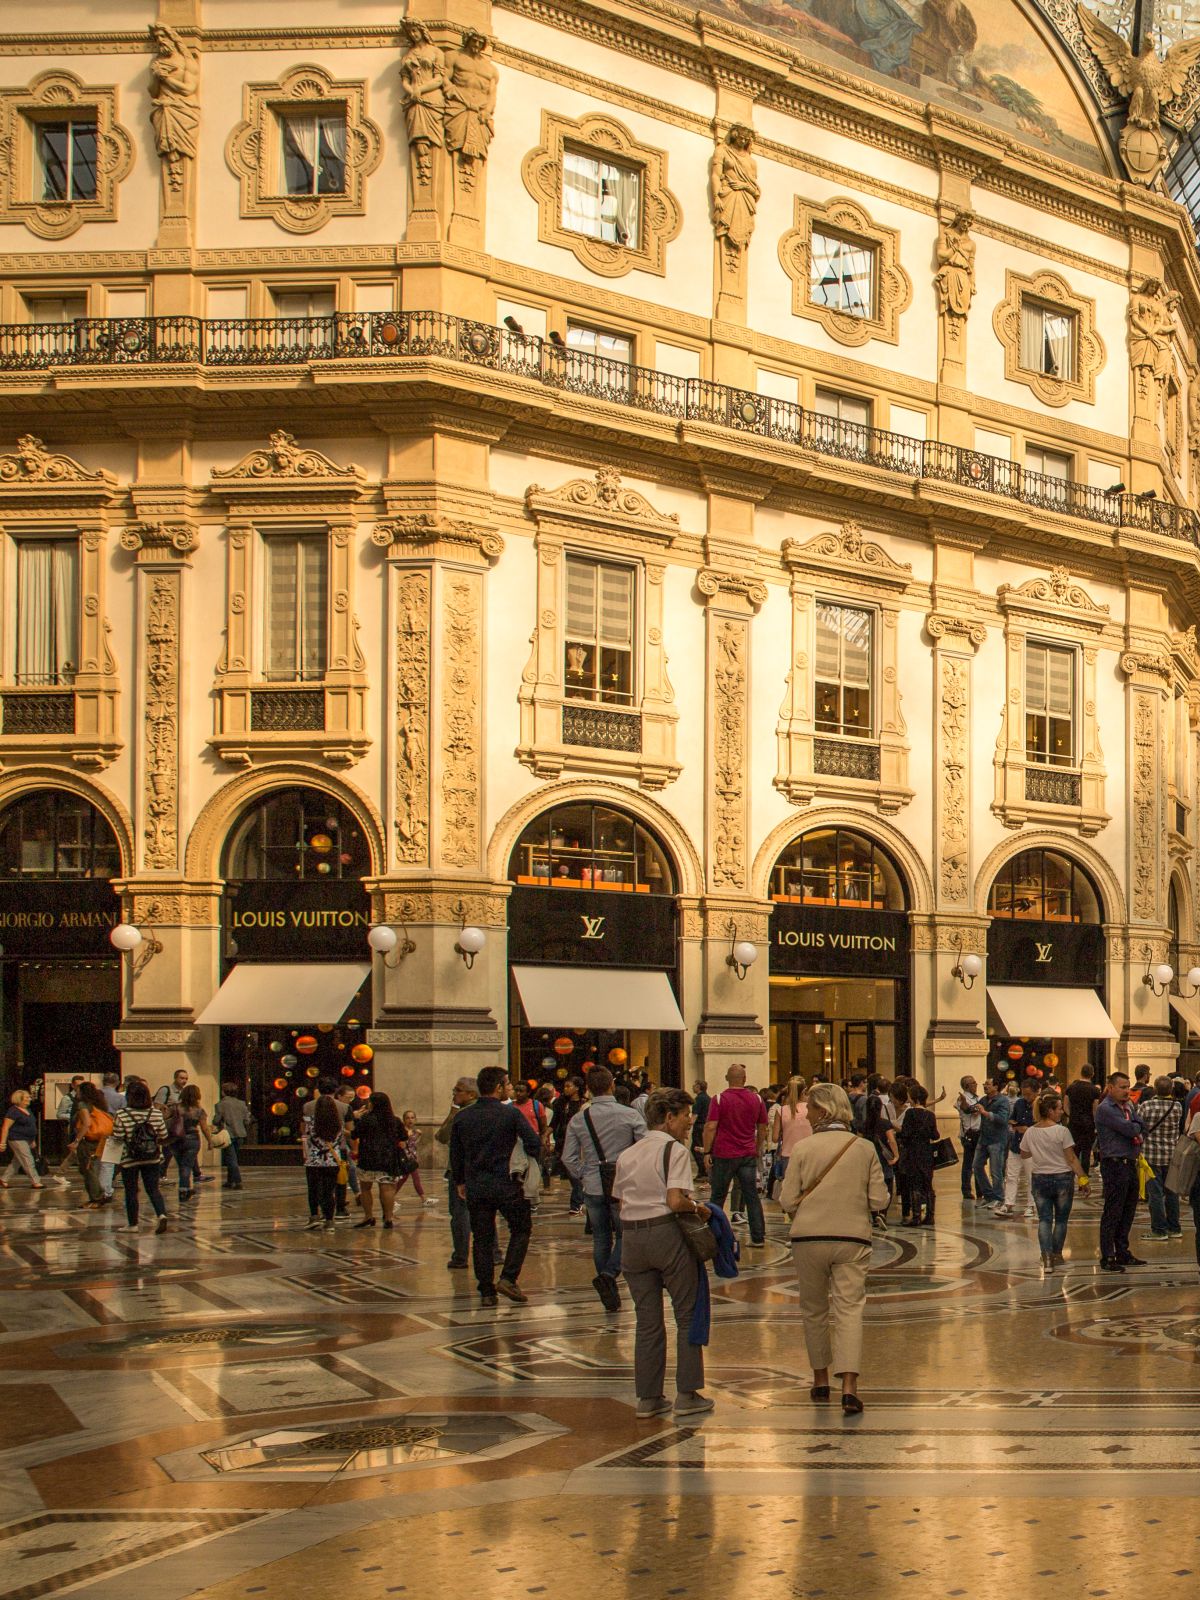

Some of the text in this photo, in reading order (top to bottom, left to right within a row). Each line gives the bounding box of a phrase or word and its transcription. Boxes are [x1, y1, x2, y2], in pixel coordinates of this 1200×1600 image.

[0, 911, 118, 928] IORGIO ARMANI
[233, 910, 369, 927] LOUIS VUITTON
[778, 930, 896, 951] LOUIS VUITTON
